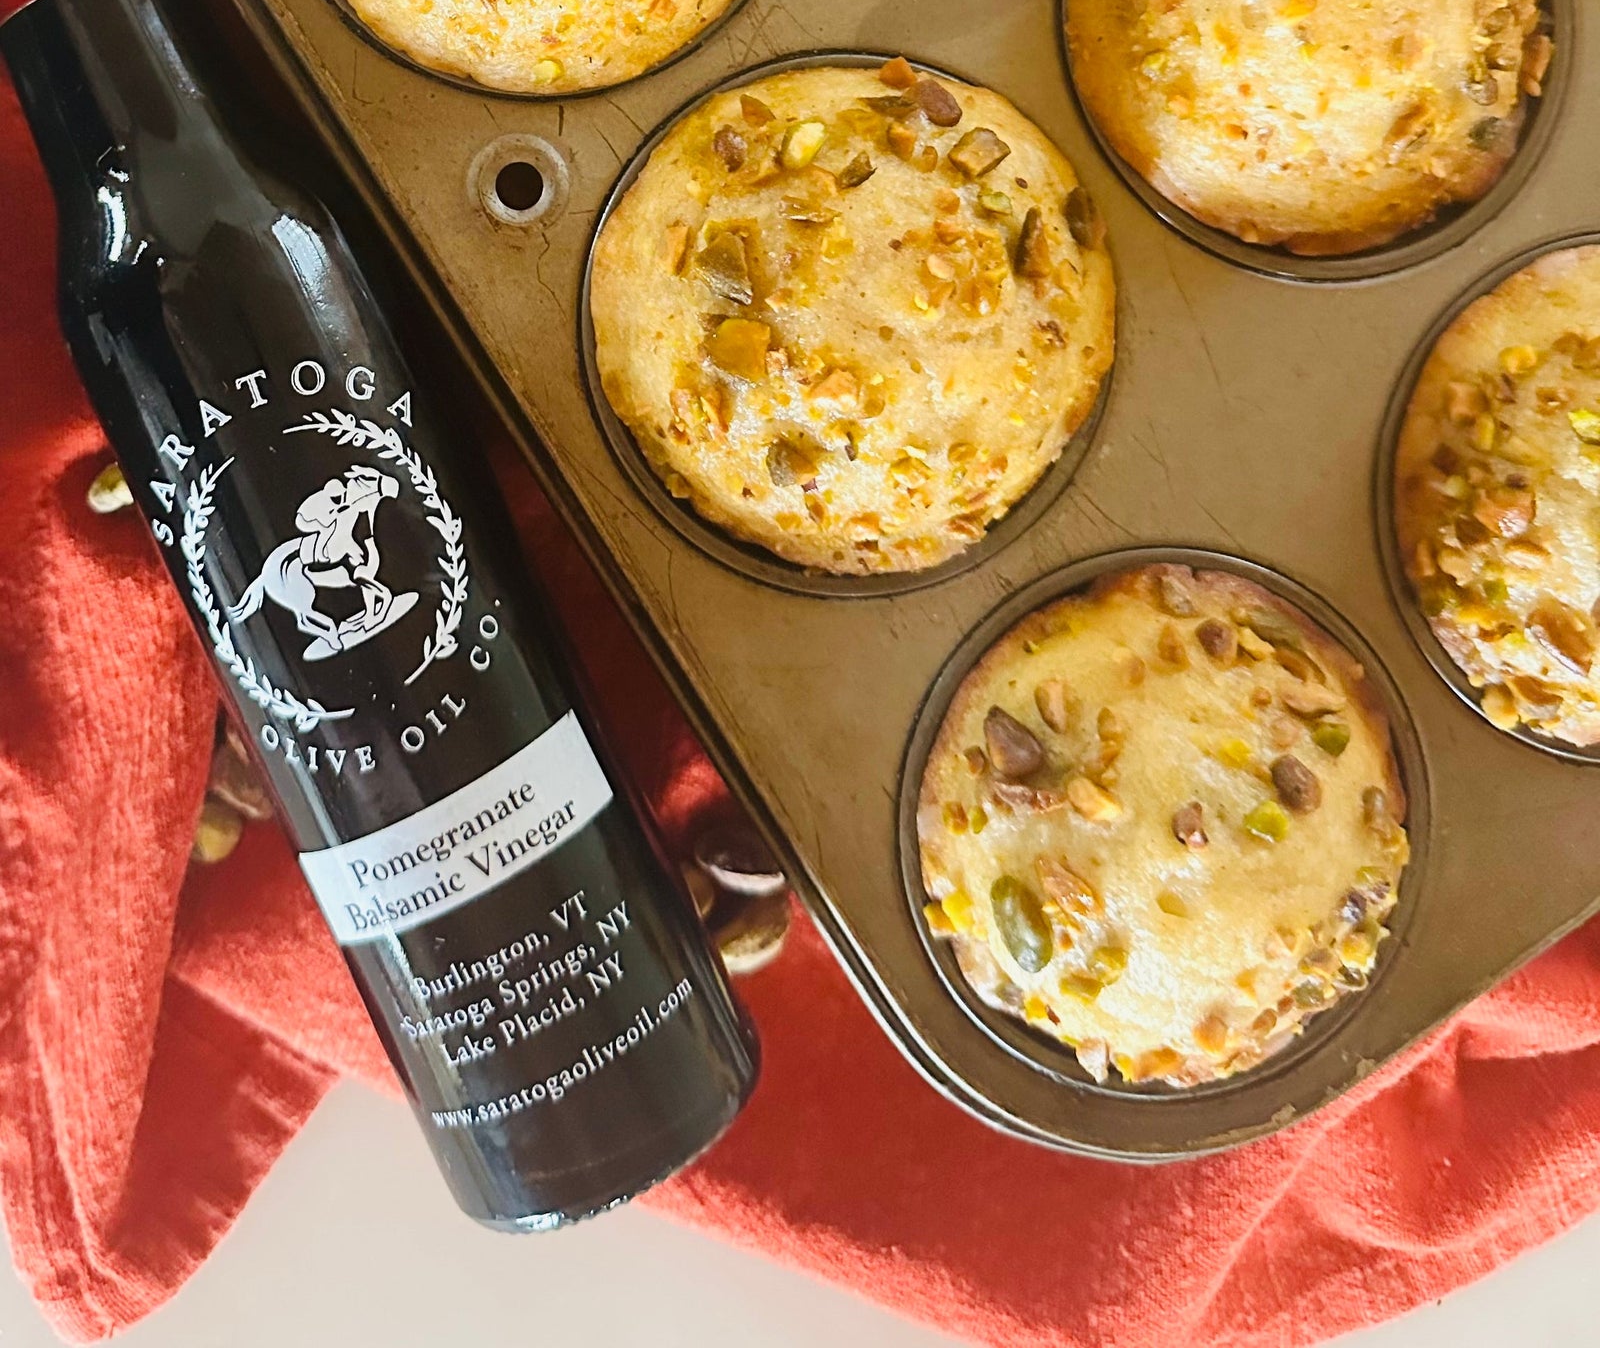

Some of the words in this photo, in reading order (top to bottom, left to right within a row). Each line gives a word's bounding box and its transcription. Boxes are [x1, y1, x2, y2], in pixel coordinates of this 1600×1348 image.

[149, 360, 414, 547] SARATOGA
[260, 723, 376, 775] OLIVE
[400, 693, 467, 752] OIL
[469, 599, 501, 672] CO.
[344, 866, 466, 932] Balsamic
[465, 798, 577, 879] Vinegar
[347, 779, 536, 889] Pomegranate
[402, 997, 496, 1039] Saratoga
[498, 943, 596, 1005] Springs,
[596, 900, 633, 945] NY
[413, 926, 550, 1001] Burlington,
[549, 890, 588, 933] VT
[438, 1033, 497, 1069] Lake
[498, 988, 586, 1047] Placid,
[586, 951, 626, 997] NY
[431, 977, 694, 1129] www.saratogaoliveoil.com
